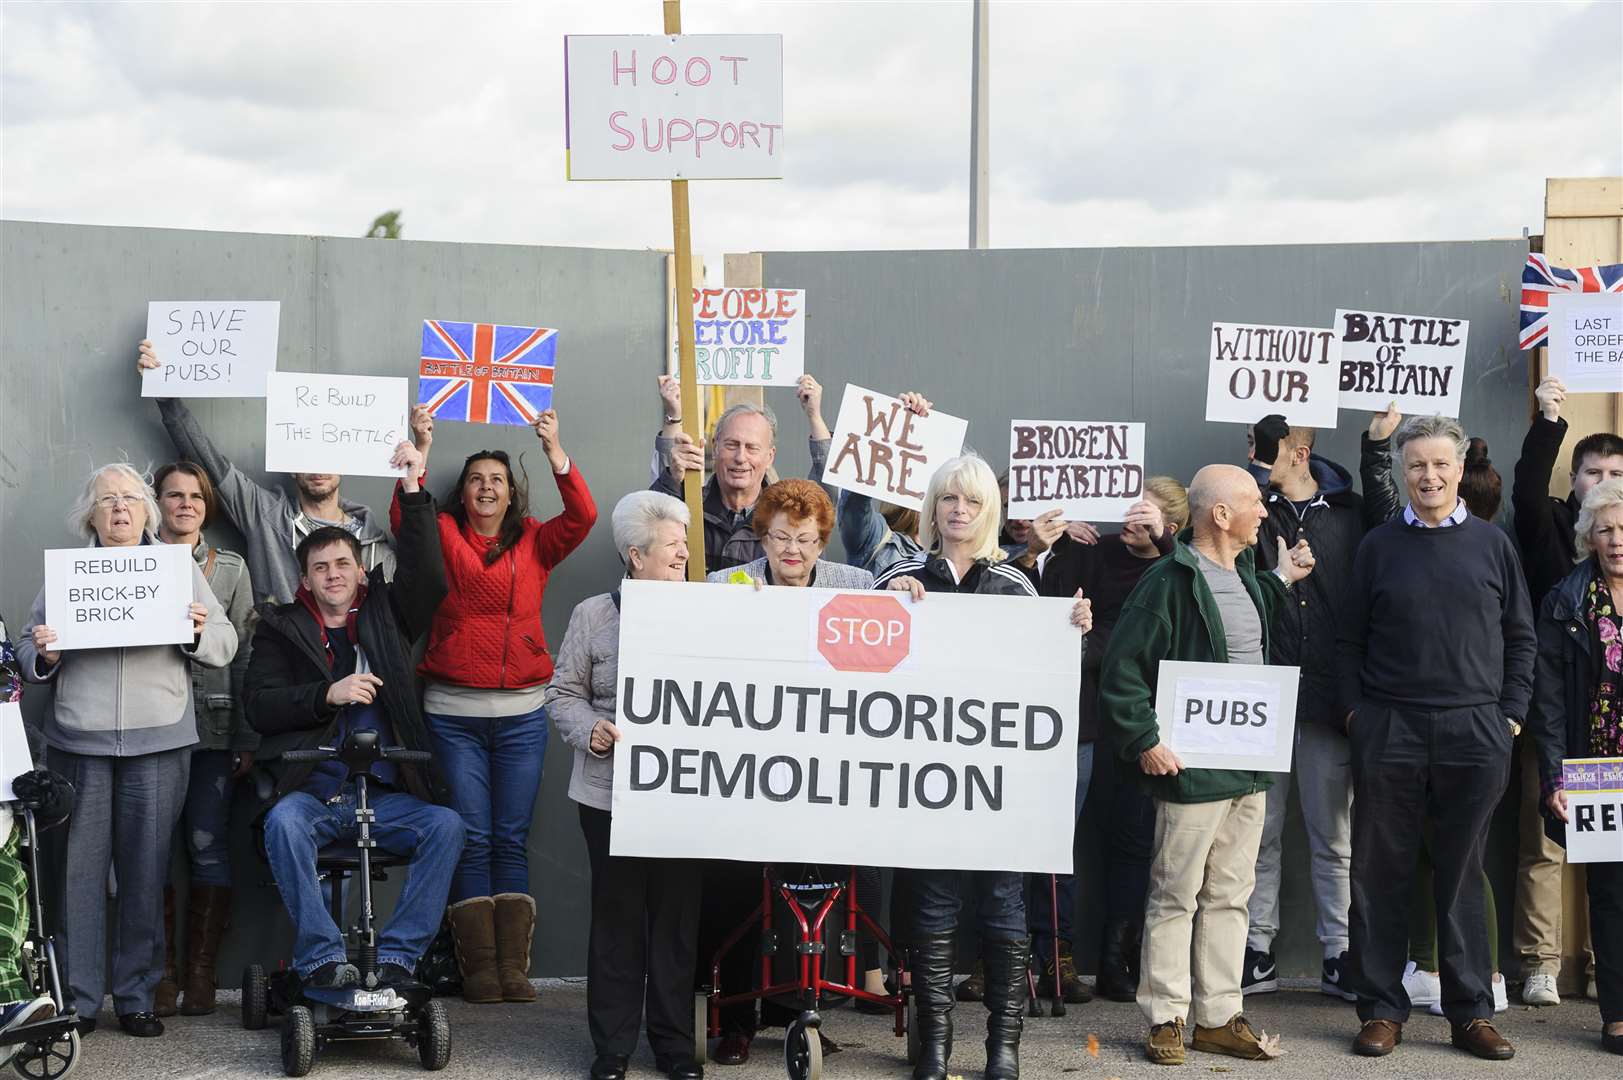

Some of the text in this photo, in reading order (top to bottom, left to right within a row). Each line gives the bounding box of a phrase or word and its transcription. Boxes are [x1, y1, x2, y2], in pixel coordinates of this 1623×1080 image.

[612, 49, 748, 87] HOOT
[608, 110, 782, 159] SUPPORT
[167, 308, 246, 335] SAVE
[676, 319, 788, 346] EFORE
[1342, 312, 1461, 347] BATTLE
[1575, 318, 1612, 331] LAST
[181, 338, 237, 356] OUR
[1214, 326, 1335, 364] WITHOUT
[1376, 344, 1406, 364] OF
[1575, 351, 1604, 363] THE
[165, 362, 231, 383] PUBS!
[425, 361, 540, 381] BATTLE OF BRITAIN
[1229, 366, 1310, 403] OUR
[1339, 360, 1454, 398] BRITAIN
[327, 387, 376, 407] BUILD
[275, 422, 313, 441] THE
[862, 395, 929, 451] WE
[1012, 425, 1129, 461] BROKEN
[829, 432, 928, 500] ARE
[1011, 463, 1143, 502] HEARTED
[74, 556, 157, 576] REBUILD
[69, 583, 160, 603] BRICK-BY
[75, 604, 135, 623] BRICK
[825, 616, 905, 647] STOP
[622, 676, 1064, 752] UNAUTHORISED
[1184, 698, 1268, 728] PUBS
[629, 744, 1003, 812] DEMOLITION
[1575, 804, 1623, 832] RE
